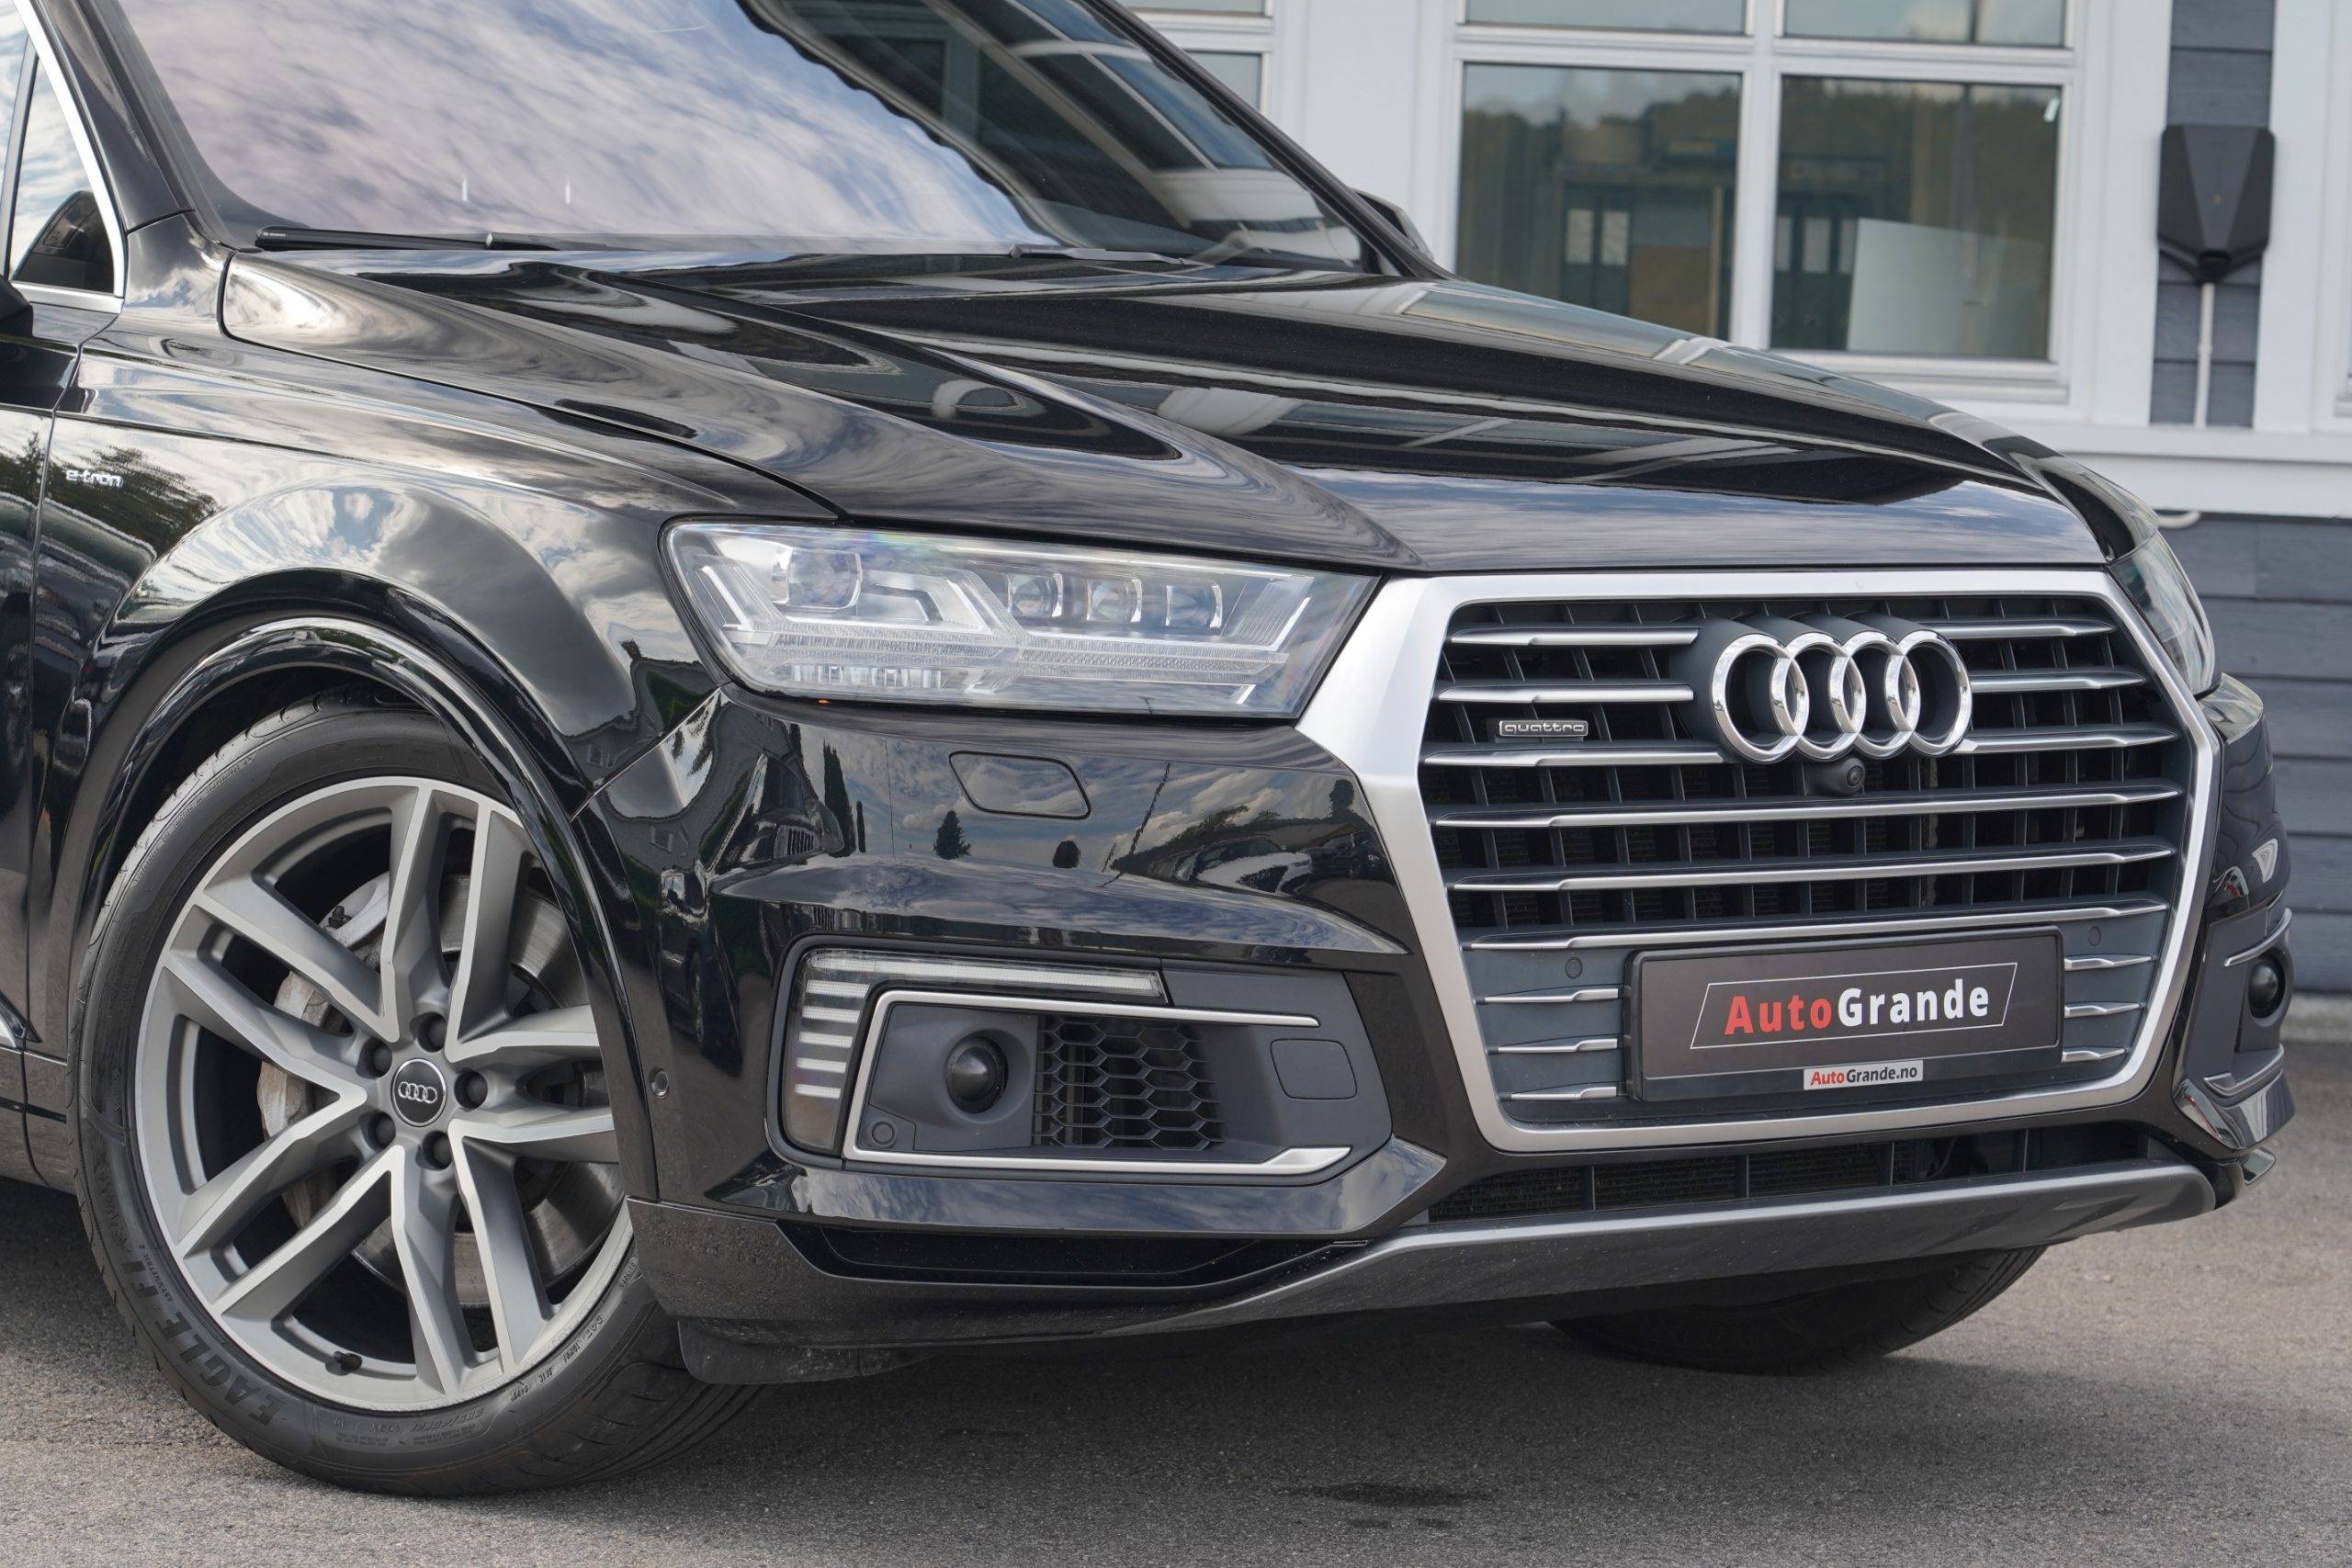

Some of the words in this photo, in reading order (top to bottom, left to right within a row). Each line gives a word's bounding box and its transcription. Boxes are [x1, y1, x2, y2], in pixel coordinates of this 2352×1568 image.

[65, 469, 123, 488] e-tron
[1504, 722, 1585, 734] quattro
[1724, 978, 1989, 1035] AutoGrande
[1810, 1066, 1917, 1086] AutoGrande.no
[120, 1260, 159, 1299] F1
[154, 1311, 288, 1427] EAGLE
